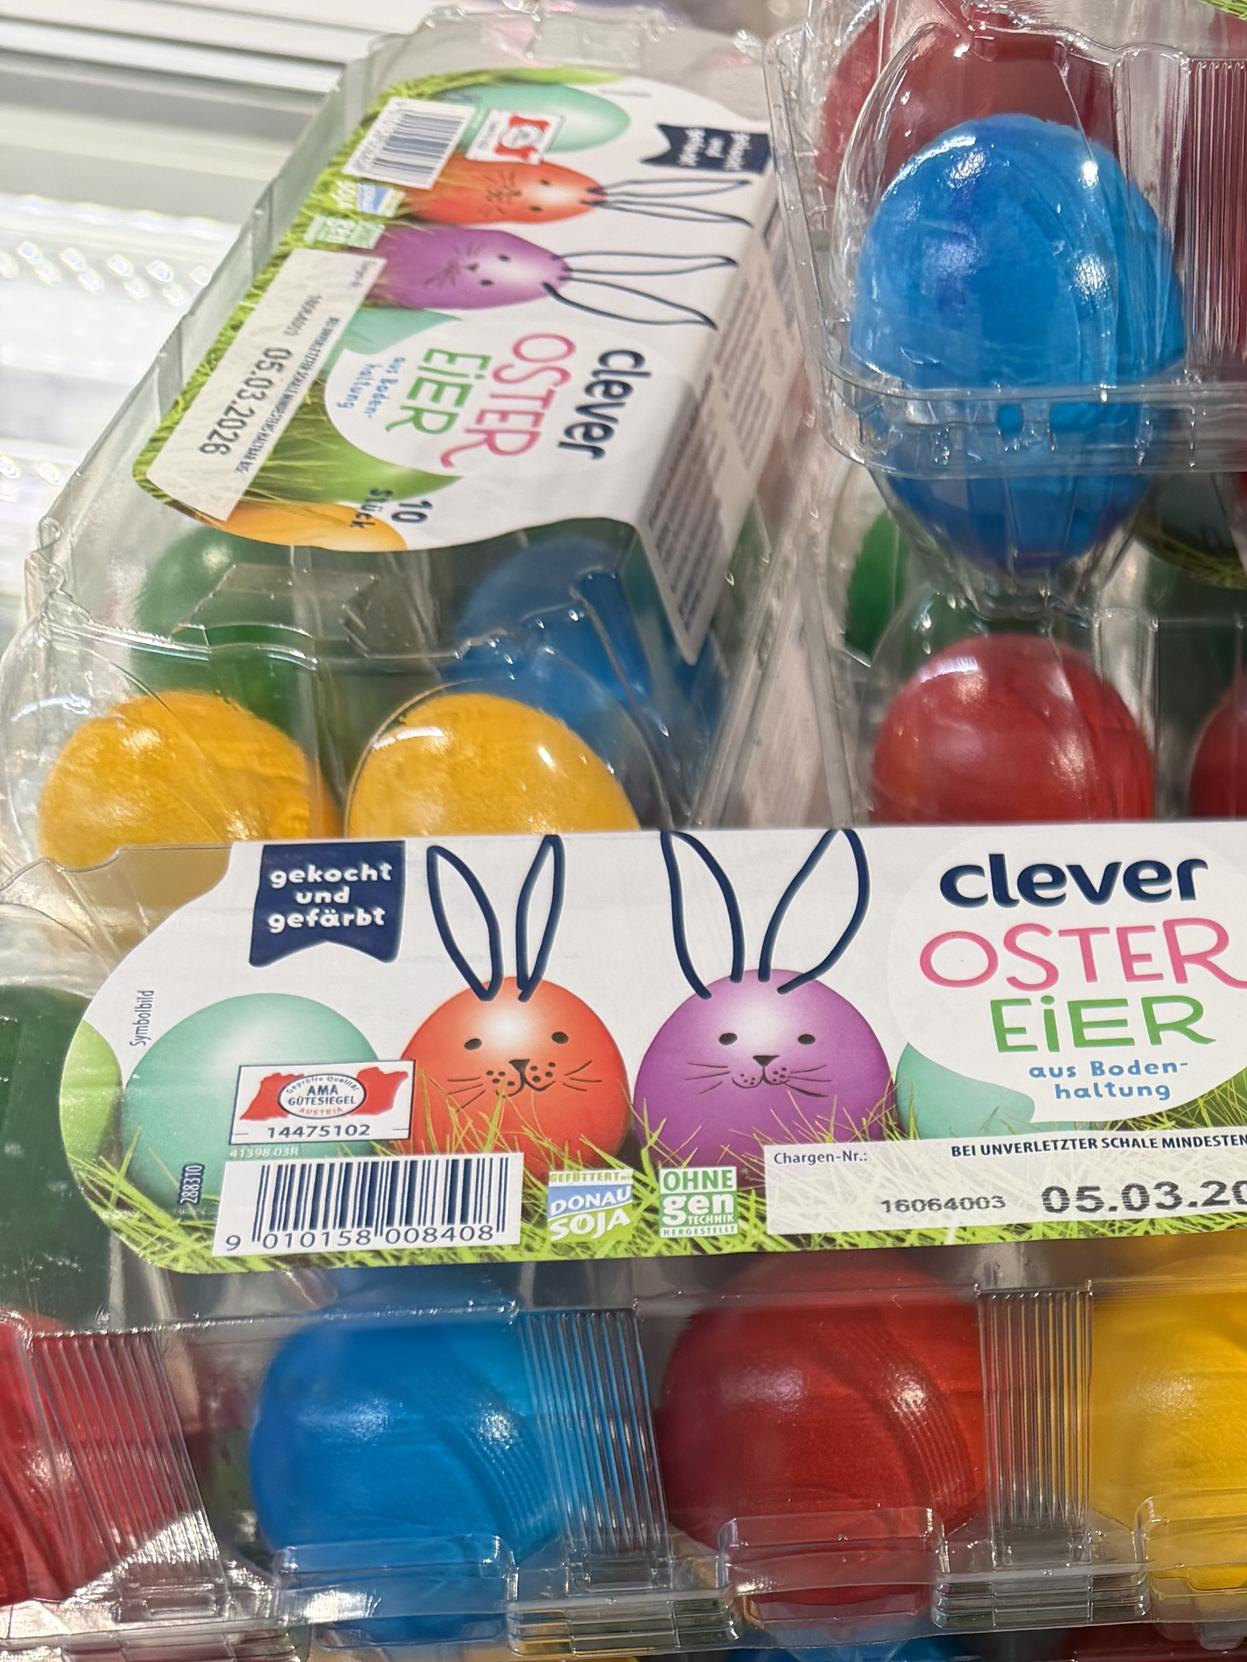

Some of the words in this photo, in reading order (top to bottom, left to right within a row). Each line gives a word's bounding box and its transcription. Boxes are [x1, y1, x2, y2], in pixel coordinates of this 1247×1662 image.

[199, 347, 292, 455] 05.03.2026
[440, 333, 576, 468] OSTER
[558, 350, 651, 459] clever
[391, 500, 433, 524] 10
[269, 862, 393, 889] gekocht
[939, 853, 1208, 907] clever
[296, 886, 350, 905] und
[267, 906, 387, 933] gefärbt
[130, 990, 154, 1047] Symbolbild
[1029, 1061, 1078, 1080] aus
[1090, 1059, 1189, 1078] Boden-
[288, 1095, 356, 1107] GÜTESIEGEL
[307, 1084, 338, 1097] AMA
[1054, 1080, 1172, 1101] haltung
[299, 1107, 344, 1117] AUSTRIA
[268, 1124, 371, 1138] 14475102
[773, 1150, 868, 1166] Chargen-Nr.:
[951, 1145, 977, 1158] BEI
[980, 1139, 1098, 1156] UNVERLETZTER
[1101, 1137, 1158, 1151] SCHALE
[180, 1164, 203, 1204] 288310
[551, 1171, 620, 1184] GEFÜTTERT
[662, 1169, 733, 1191] OHNE
[550, 1186, 631, 1217] DONAU
[663, 1193, 735, 1226] gen
[880, 1195, 1006, 1214] 16064003
[550, 1208, 631, 1242] SOJA
[688, 1214, 735, 1225] TECHNIK
[226, 1235, 241, 1251] 9
[262, 1230, 371, 1249] 010158
[385, 1225, 493, 1244] 008408
[662, 1225, 735, 1238] HERGESTELLT
